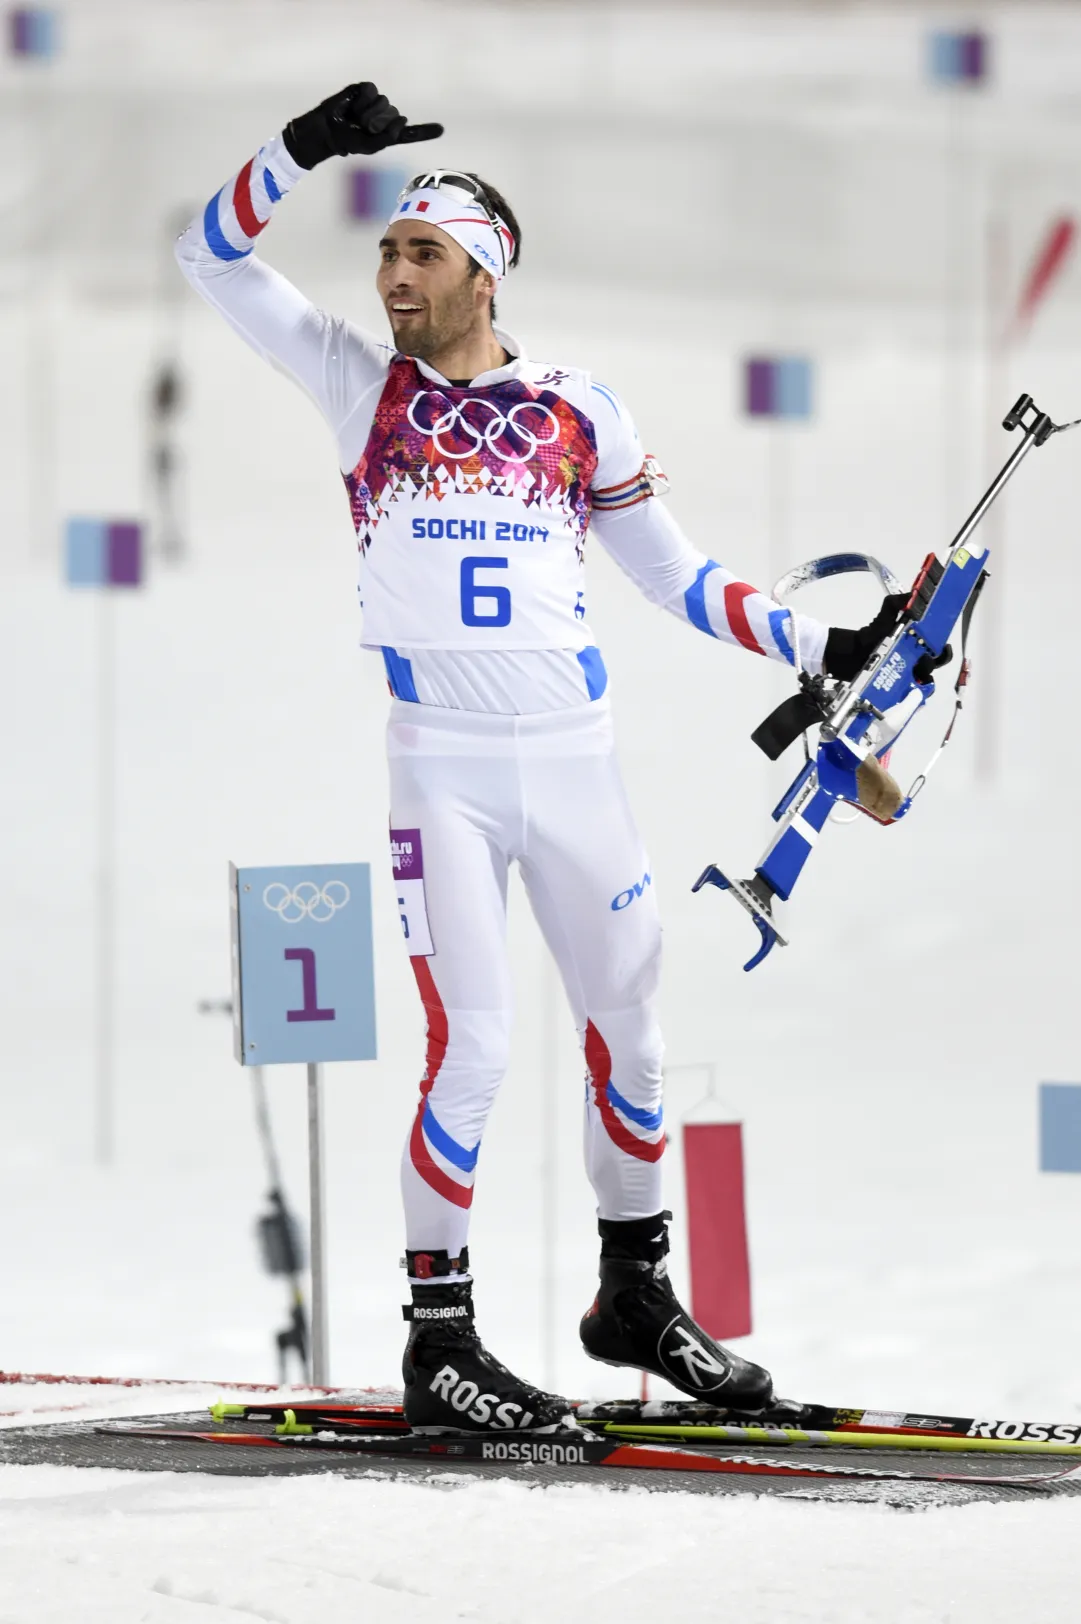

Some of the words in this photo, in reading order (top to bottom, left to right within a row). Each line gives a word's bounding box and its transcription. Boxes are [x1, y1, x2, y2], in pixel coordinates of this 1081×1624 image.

[412, 517, 486, 540] SOCHI
[495, 521, 550, 543] 2014
[460, 556, 511, 627] 6
[284, 948, 336, 1022] 1
[413, 1305, 468, 1319] ROSSIGNOL
[482, 1442, 589, 1463] ROSSIGNOL
